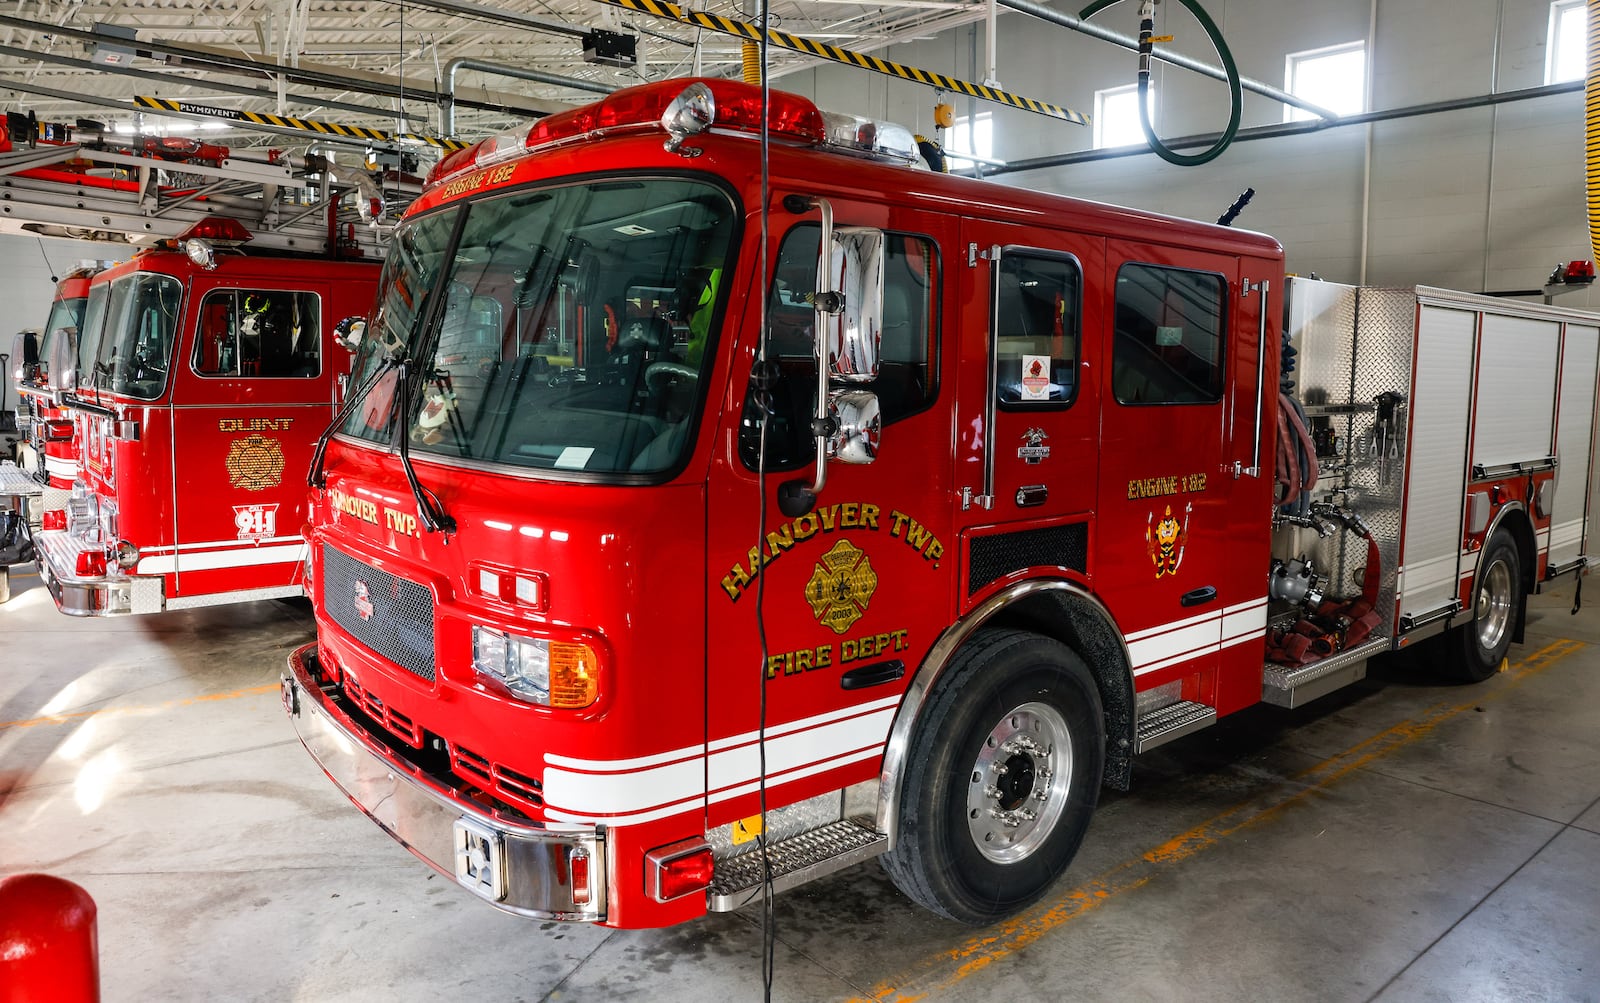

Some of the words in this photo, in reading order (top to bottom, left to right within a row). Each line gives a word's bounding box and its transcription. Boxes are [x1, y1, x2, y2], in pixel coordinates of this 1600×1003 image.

[441, 172, 487, 200] ENGINE
[486, 163, 518, 186] 182
[219, 418, 294, 432] QUINT
[1127, 476, 1178, 500] ENGINE
[1182, 473, 1207, 493] 182
[384, 506, 420, 539] TWP.
[720, 502, 881, 603] HANOVER
[889, 509, 945, 570] TWP.
[832, 608, 852, 620] 2003
[765, 644, 833, 680] FIRE
[841, 629, 910, 664] DEPT.
